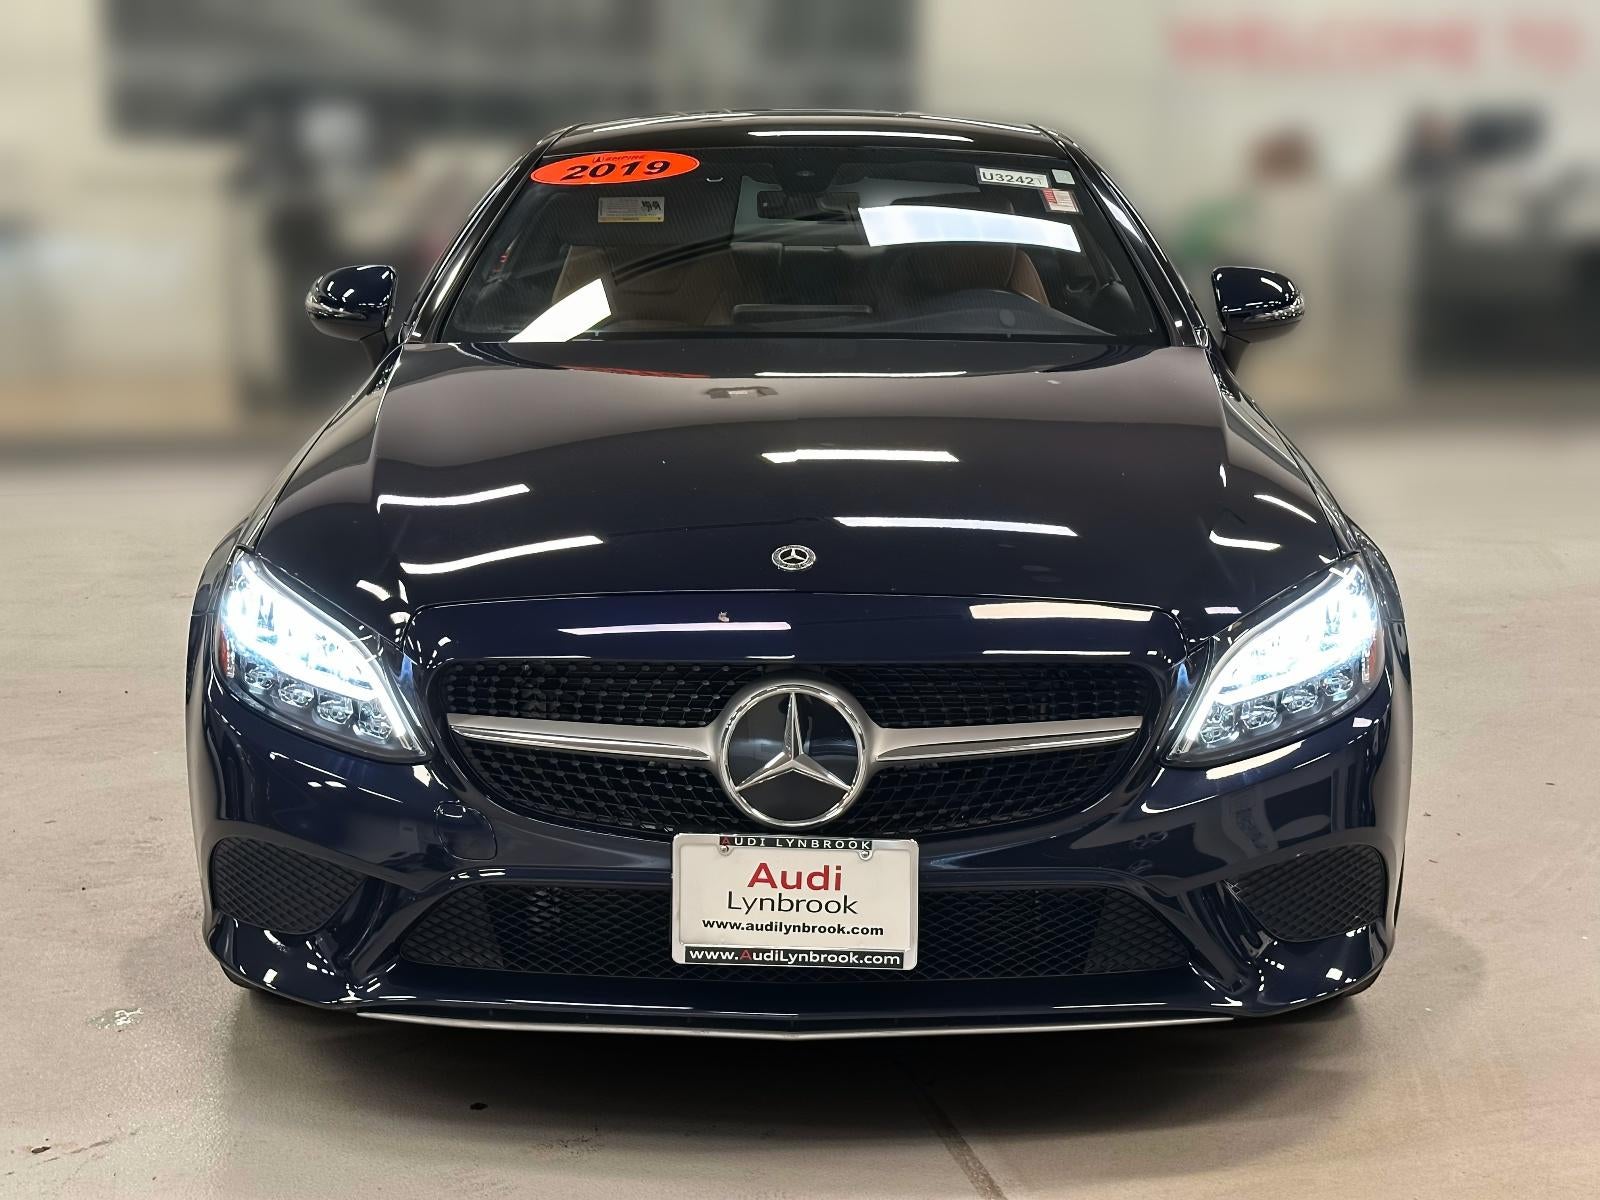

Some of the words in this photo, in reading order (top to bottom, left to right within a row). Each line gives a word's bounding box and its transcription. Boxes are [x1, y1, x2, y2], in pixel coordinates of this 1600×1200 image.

[561, 160, 670, 181] 2019
[721, 836, 766, 847] AUDI
[776, 838, 871, 850] LYNBROOK
[747, 862, 842, 891] Audi
[727, 891, 858, 915] Lynbrook
[702, 920, 884, 936] www.audilynbrook.com
[689, 948, 901, 965] www.AudiLynbrook.com
